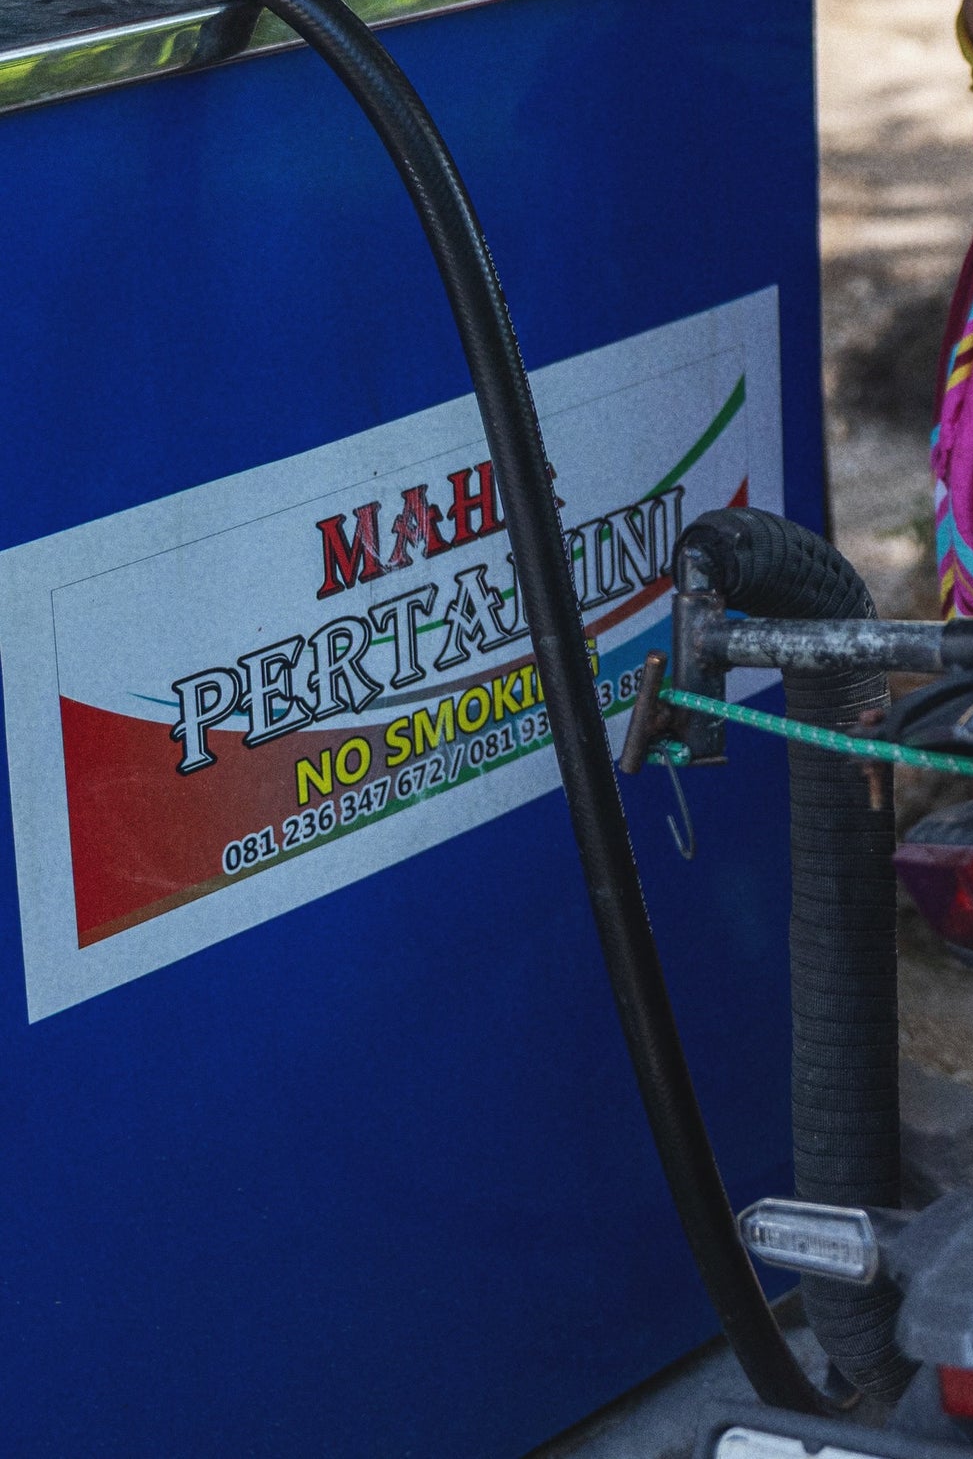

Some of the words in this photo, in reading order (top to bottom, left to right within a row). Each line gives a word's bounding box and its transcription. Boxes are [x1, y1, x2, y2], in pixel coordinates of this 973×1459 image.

[316, 459, 567, 600] MAH
[224, 827, 278, 874] 081
[283, 802, 334, 848] 236
[342, 778, 391, 823] 347
[397, 756, 443, 797] 672
[449, 744, 464, 780] /
[469, 727, 514, 765] 081
[521, 711, 549, 742] 93
[295, 736, 373, 808] NO
[383, 638, 600, 768] SMOKI
